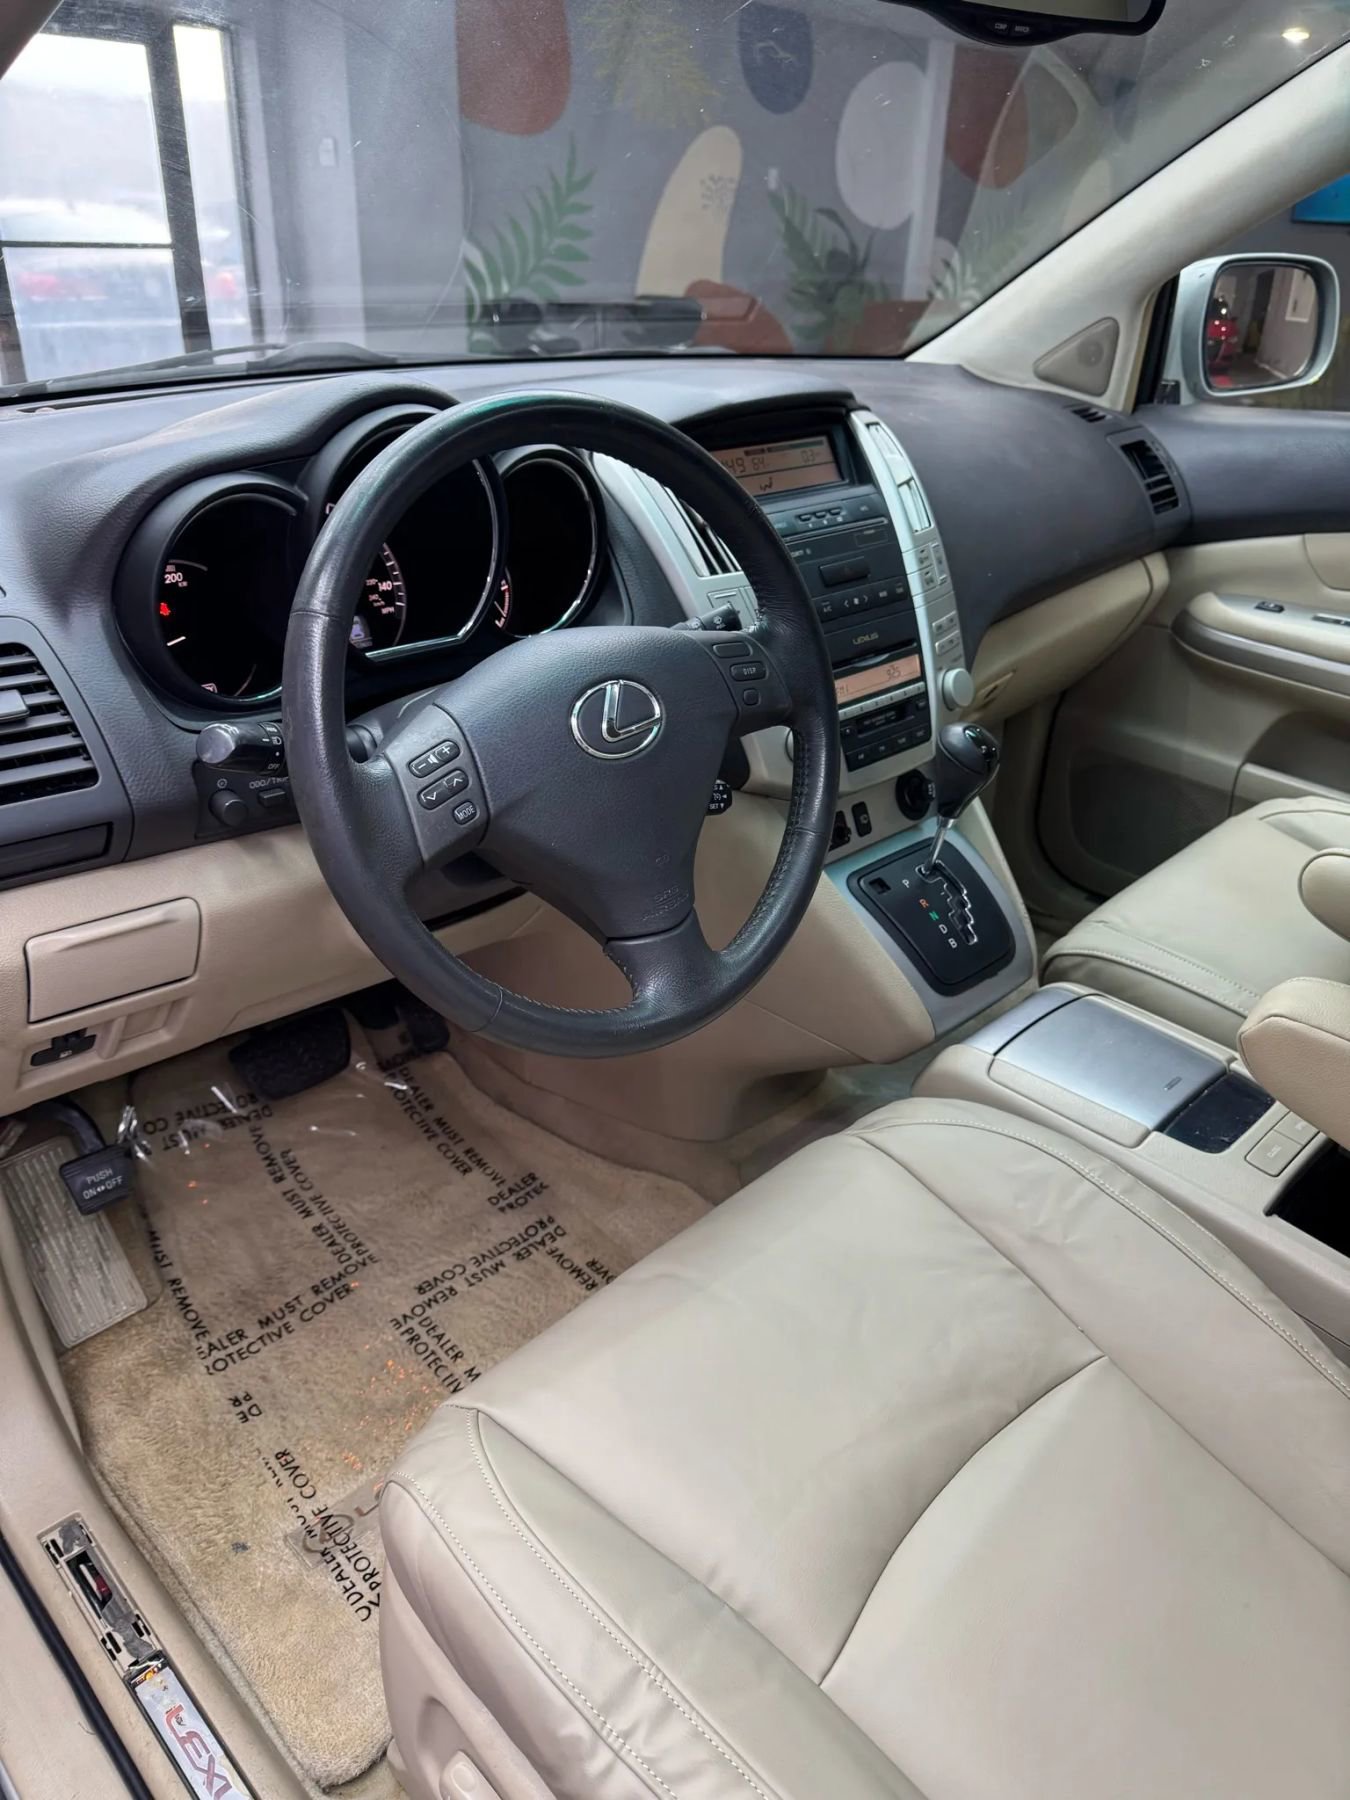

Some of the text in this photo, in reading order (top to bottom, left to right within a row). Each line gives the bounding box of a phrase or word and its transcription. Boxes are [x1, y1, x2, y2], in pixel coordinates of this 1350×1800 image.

[164, 572, 183, 584] 200
[377, 581, 393, 591] 140
[459, 804, 476, 820] MODE
[902, 879, 910, 889] P
[919, 898, 930, 909] R
[928, 911, 940, 921] N
[939, 924, 949, 935] D
[948, 937, 958, 949] B
[433, 1116, 465, 1146] MUST
[86, 1167, 114, 1185] PUSH
[436, 1142, 474, 1177] COVER
[280, 1148, 370, 1257] PROTECTIVE COVER
[282, 1188, 315, 1219] MUST
[487, 1172, 539, 1206] DEALER
[311, 1222, 352, 1265] DEALER
[414, 1216, 555, 1295] PROTECTIVE COVER
[257, 1295, 305, 1330] MUST
[310, 1254, 381, 1297] REMOVE
[390, 1225, 567, 1331] DEALER MUST REMOVE
[168, 1277, 210, 1340] REMOVE
[299, 1282, 355, 1323] COVER
[418, 1316, 465, 1363] DEALER
[400, 1327, 465, 1395] PROTECTIV
[274, 1448, 317, 1499] COVER
[312, 1504, 382, 1592] PROTECTIVE
